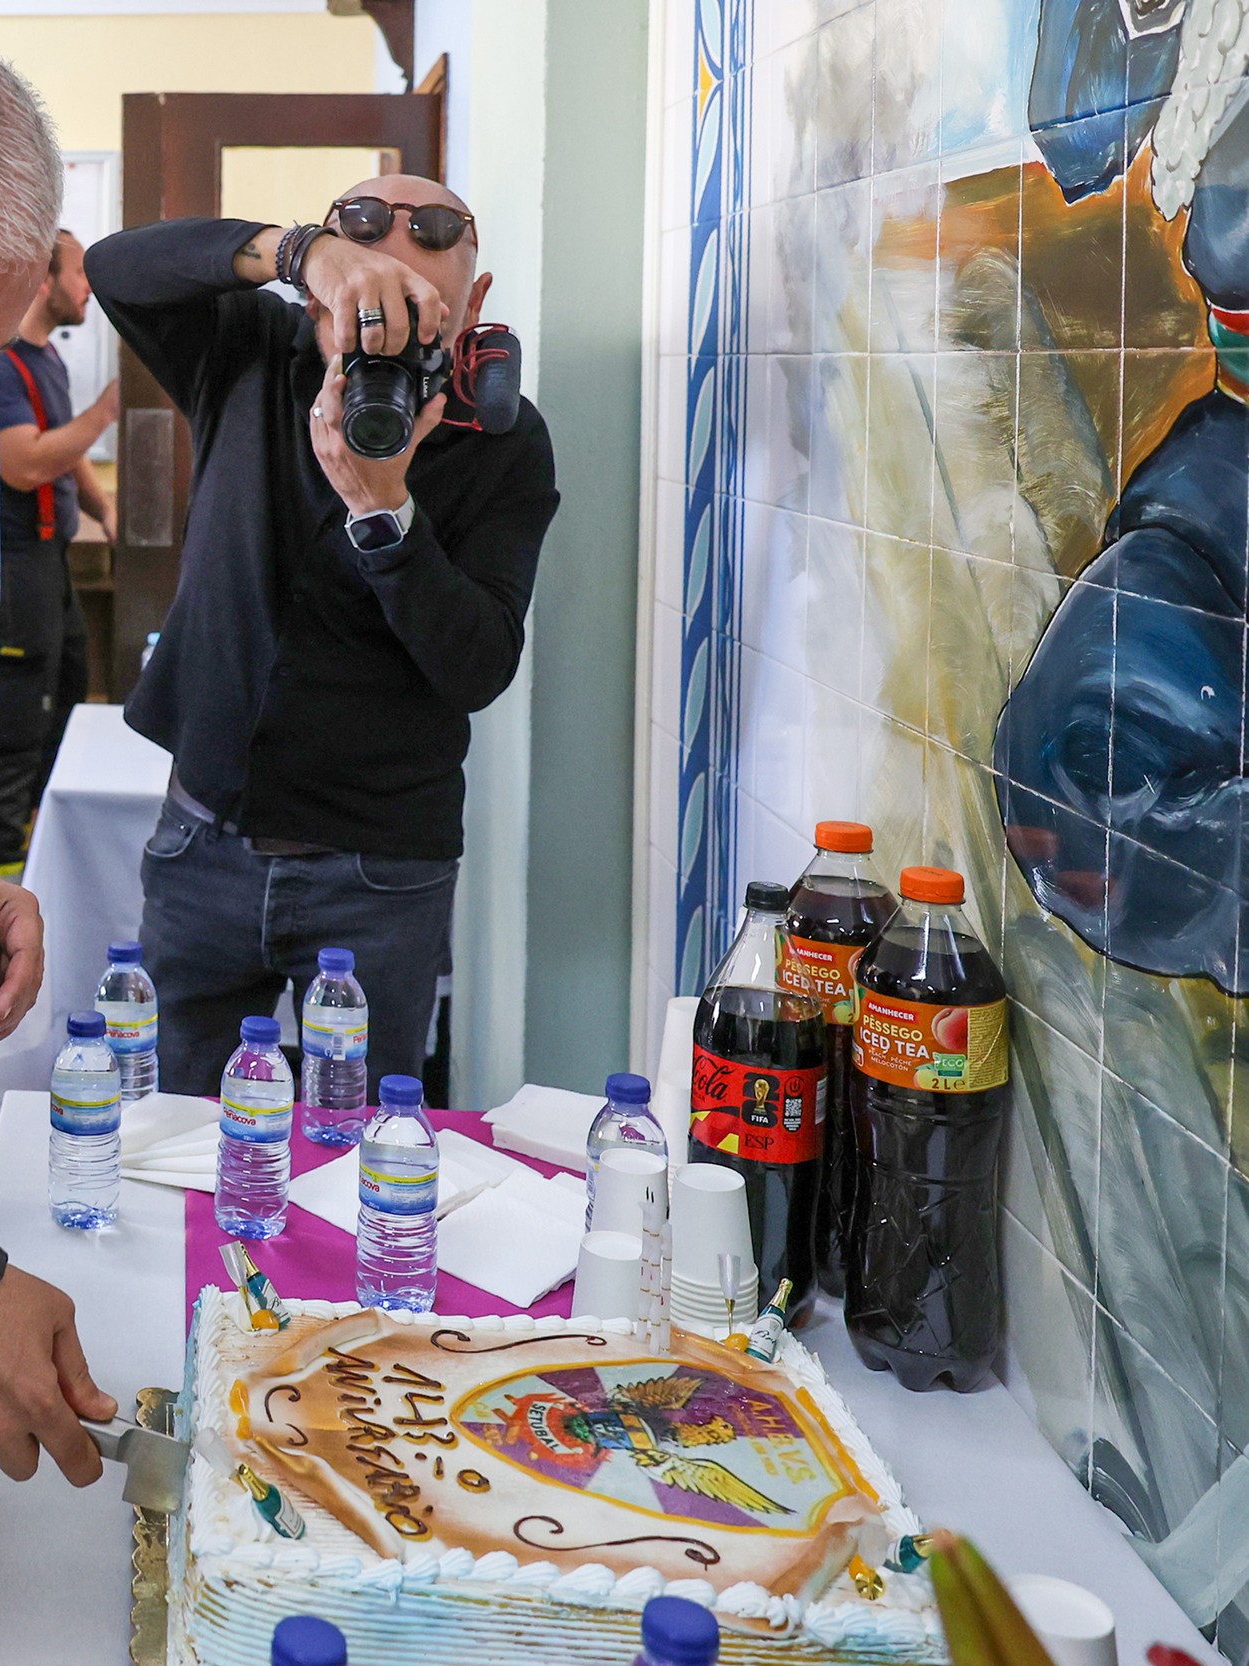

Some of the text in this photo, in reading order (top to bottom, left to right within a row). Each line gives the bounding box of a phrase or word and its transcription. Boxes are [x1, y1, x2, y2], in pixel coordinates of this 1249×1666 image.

[782, 970, 847, 997] ICED TEA
[868, 1002, 915, 1021] AMANHECER
[860, 1026, 930, 1059] ICED TEA
[931, 1078, 940, 1089] 2
[751, 1114, 769, 1124] FIFA
[744, 1133, 775, 1151] ESP
